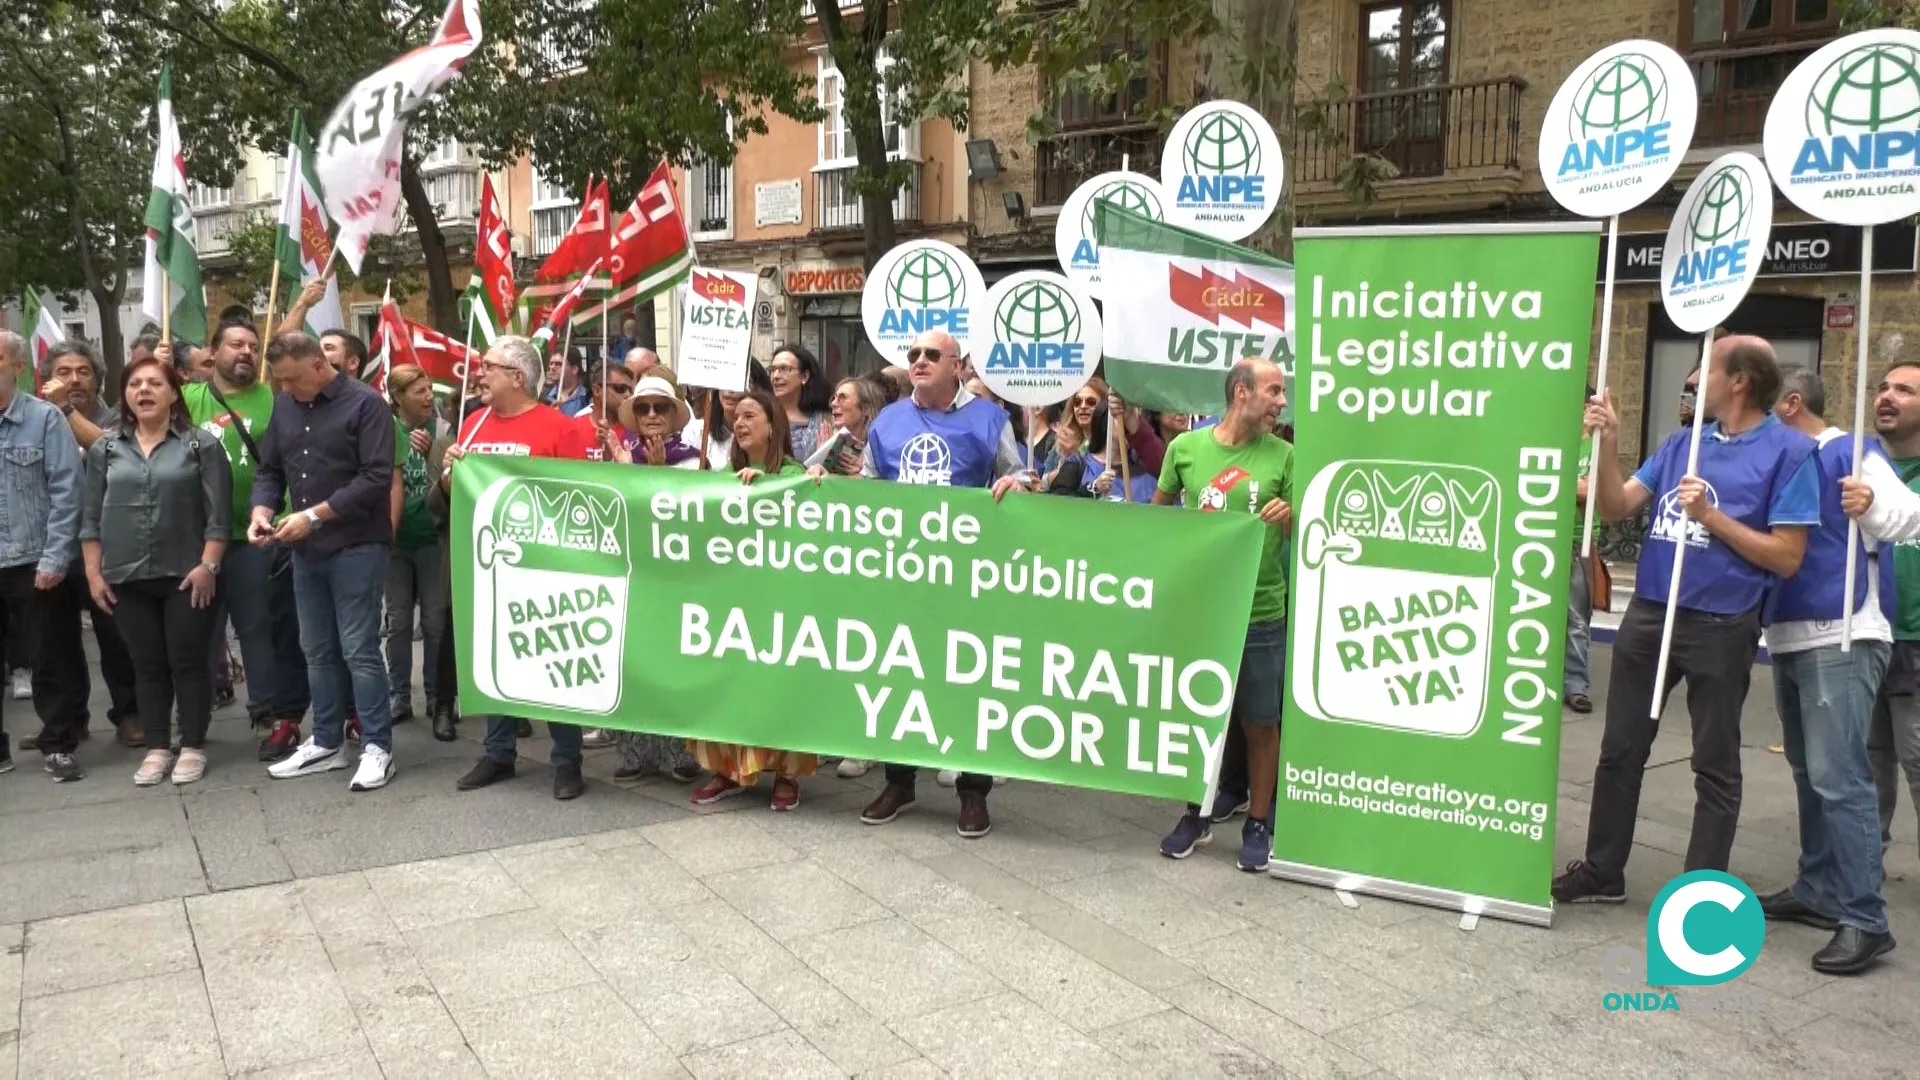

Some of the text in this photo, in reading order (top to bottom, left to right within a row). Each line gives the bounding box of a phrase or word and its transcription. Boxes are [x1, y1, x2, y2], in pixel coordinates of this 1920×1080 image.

[1557, 121, 1671, 176] ANPE
[1791, 130, 1920, 176] ANP
[1177, 175, 1265, 202] ANPE
[1578, 175, 1643, 195] ANDALUCÍA
[1790, 172, 1852, 185] SINDICATO
[1823, 182, 1915, 200] ANDALUCÍA
[1194, 213, 1246, 223] ANDALUCÍA
[787, 267, 864, 292] DEPORTES
[1670, 238, 1751, 289] ANPE
[690, 304, 750, 331] USTEA
[1201, 285, 1265, 308] Cádiz
[1312, 274, 1542, 319] Iniciativa
[1682, 292, 1726, 309] ANDALUCÍA
[878, 307, 969, 334] ANPE
[985, 342, 1085, 368] ANPE
[1168, 327, 1295, 373] USTEA
[1311, 323, 1573, 375] Legislativa
[1006, 378, 1063, 388] ANDALUCÍA
[1310, 370, 1492, 422] Popular
[897, 469, 952, 486] ANPE
[651, 485, 981, 544] en defensa de
[651, 523, 1154, 609] la educación pública
[508, 583, 615, 625] BAJADA
[1338, 585, 1479, 632] BAJADA
[1502, 446, 1562, 746] EDUCACIÓN
[509, 616, 613, 659] RATIO
[1336, 621, 1477, 672] RATIO
[549, 654, 606, 688] ¡YA!
[680, 603, 1233, 718] BAJADA DE RATIO
[1384, 665, 1464, 706] ¡YA!
[854, 683, 1223, 785] YA, POR LEY
[1285, 762, 1548, 824] bajadaderatioya.org
[1286, 784, 1543, 840] firma.bajadaderatioya.org
